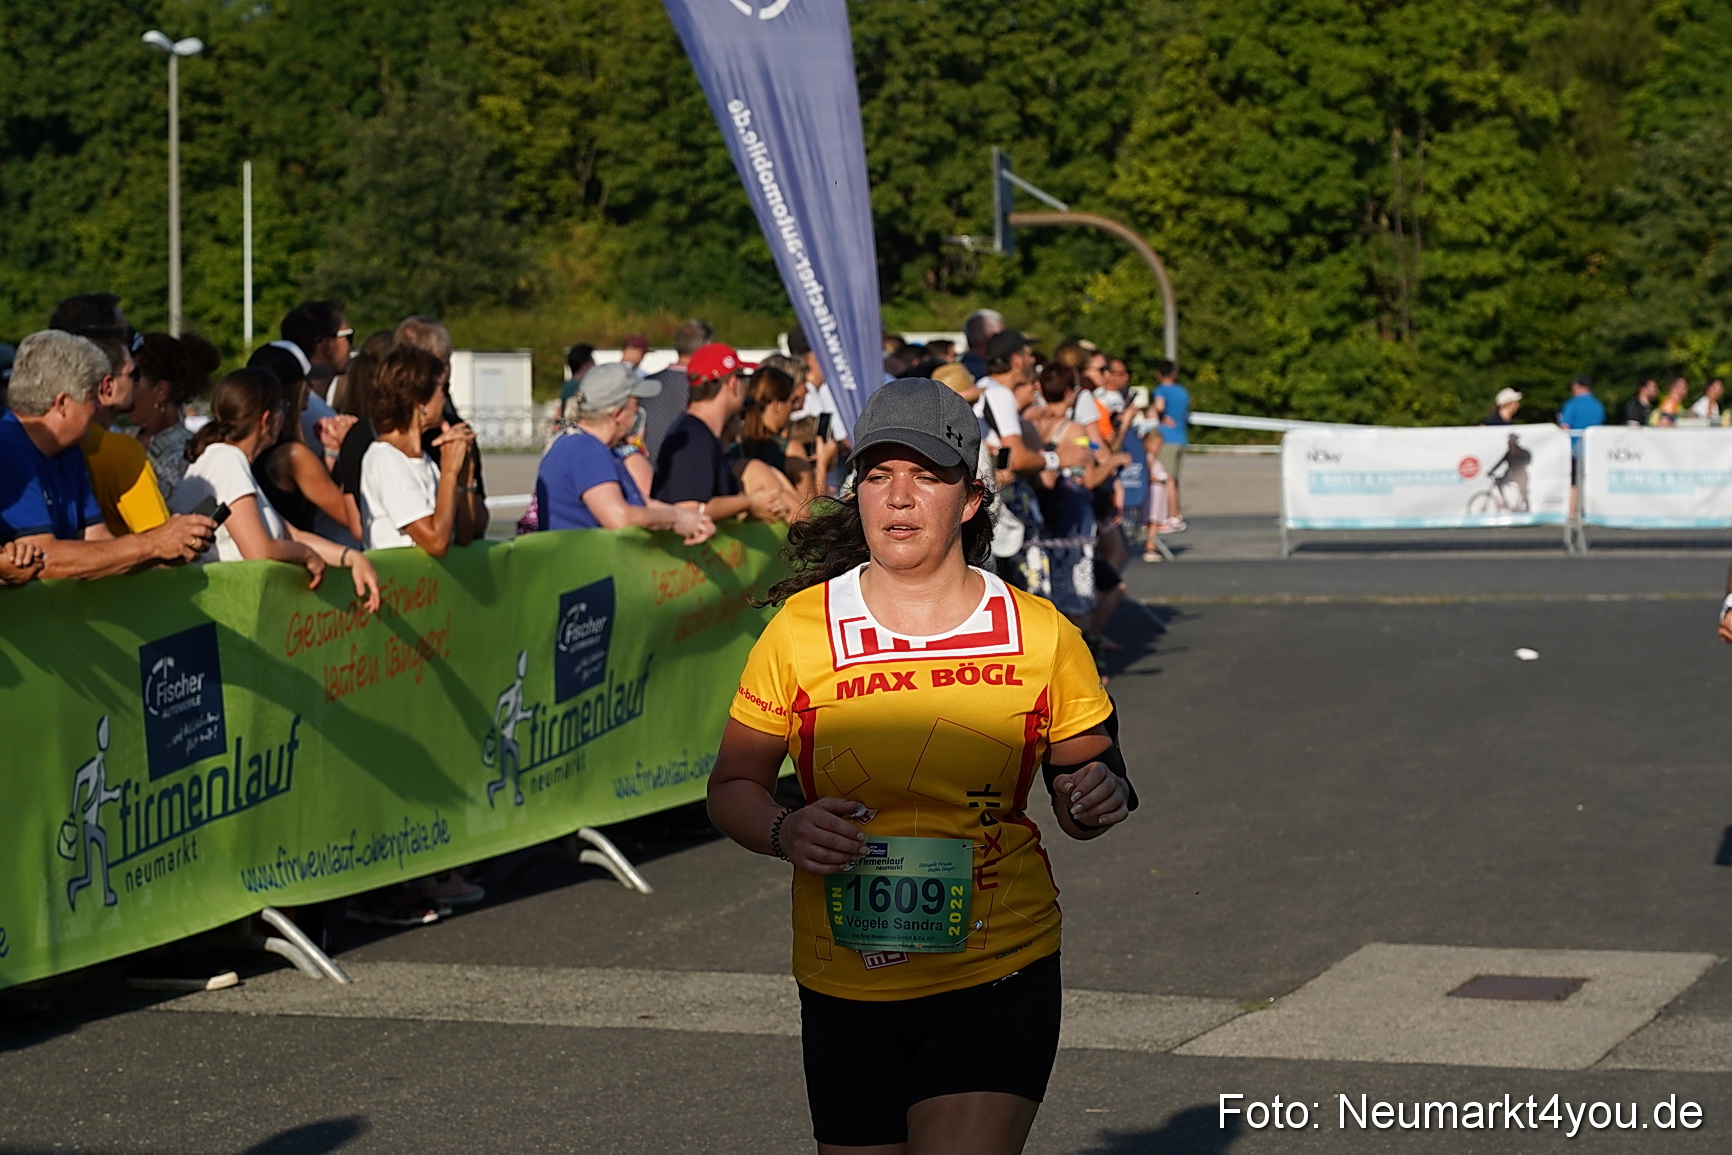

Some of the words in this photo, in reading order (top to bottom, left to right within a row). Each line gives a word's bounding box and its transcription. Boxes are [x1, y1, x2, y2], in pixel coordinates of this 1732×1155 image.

[286, 598, 371, 656] Gesunde
[565, 616, 607, 645] Fischer
[324, 644, 379, 703] laufen
[385, 611, 451, 683] länger!
[157, 672, 204, 707] Fischer
[835, 671, 918, 700] MAX
[931, 662, 1023, 687] BÖGL
[531, 653, 654, 766] firmenlauf
[120, 714, 301, 858] firmenlauf
[126, 835, 198, 892] neumarkt
[832, 887, 844, 925] RUN
[847, 875, 946, 915] 1609
[949, 885, 963, 936] 2022
[846, 915, 889, 931] Vögele
[893, 917, 943, 931] Sandra
